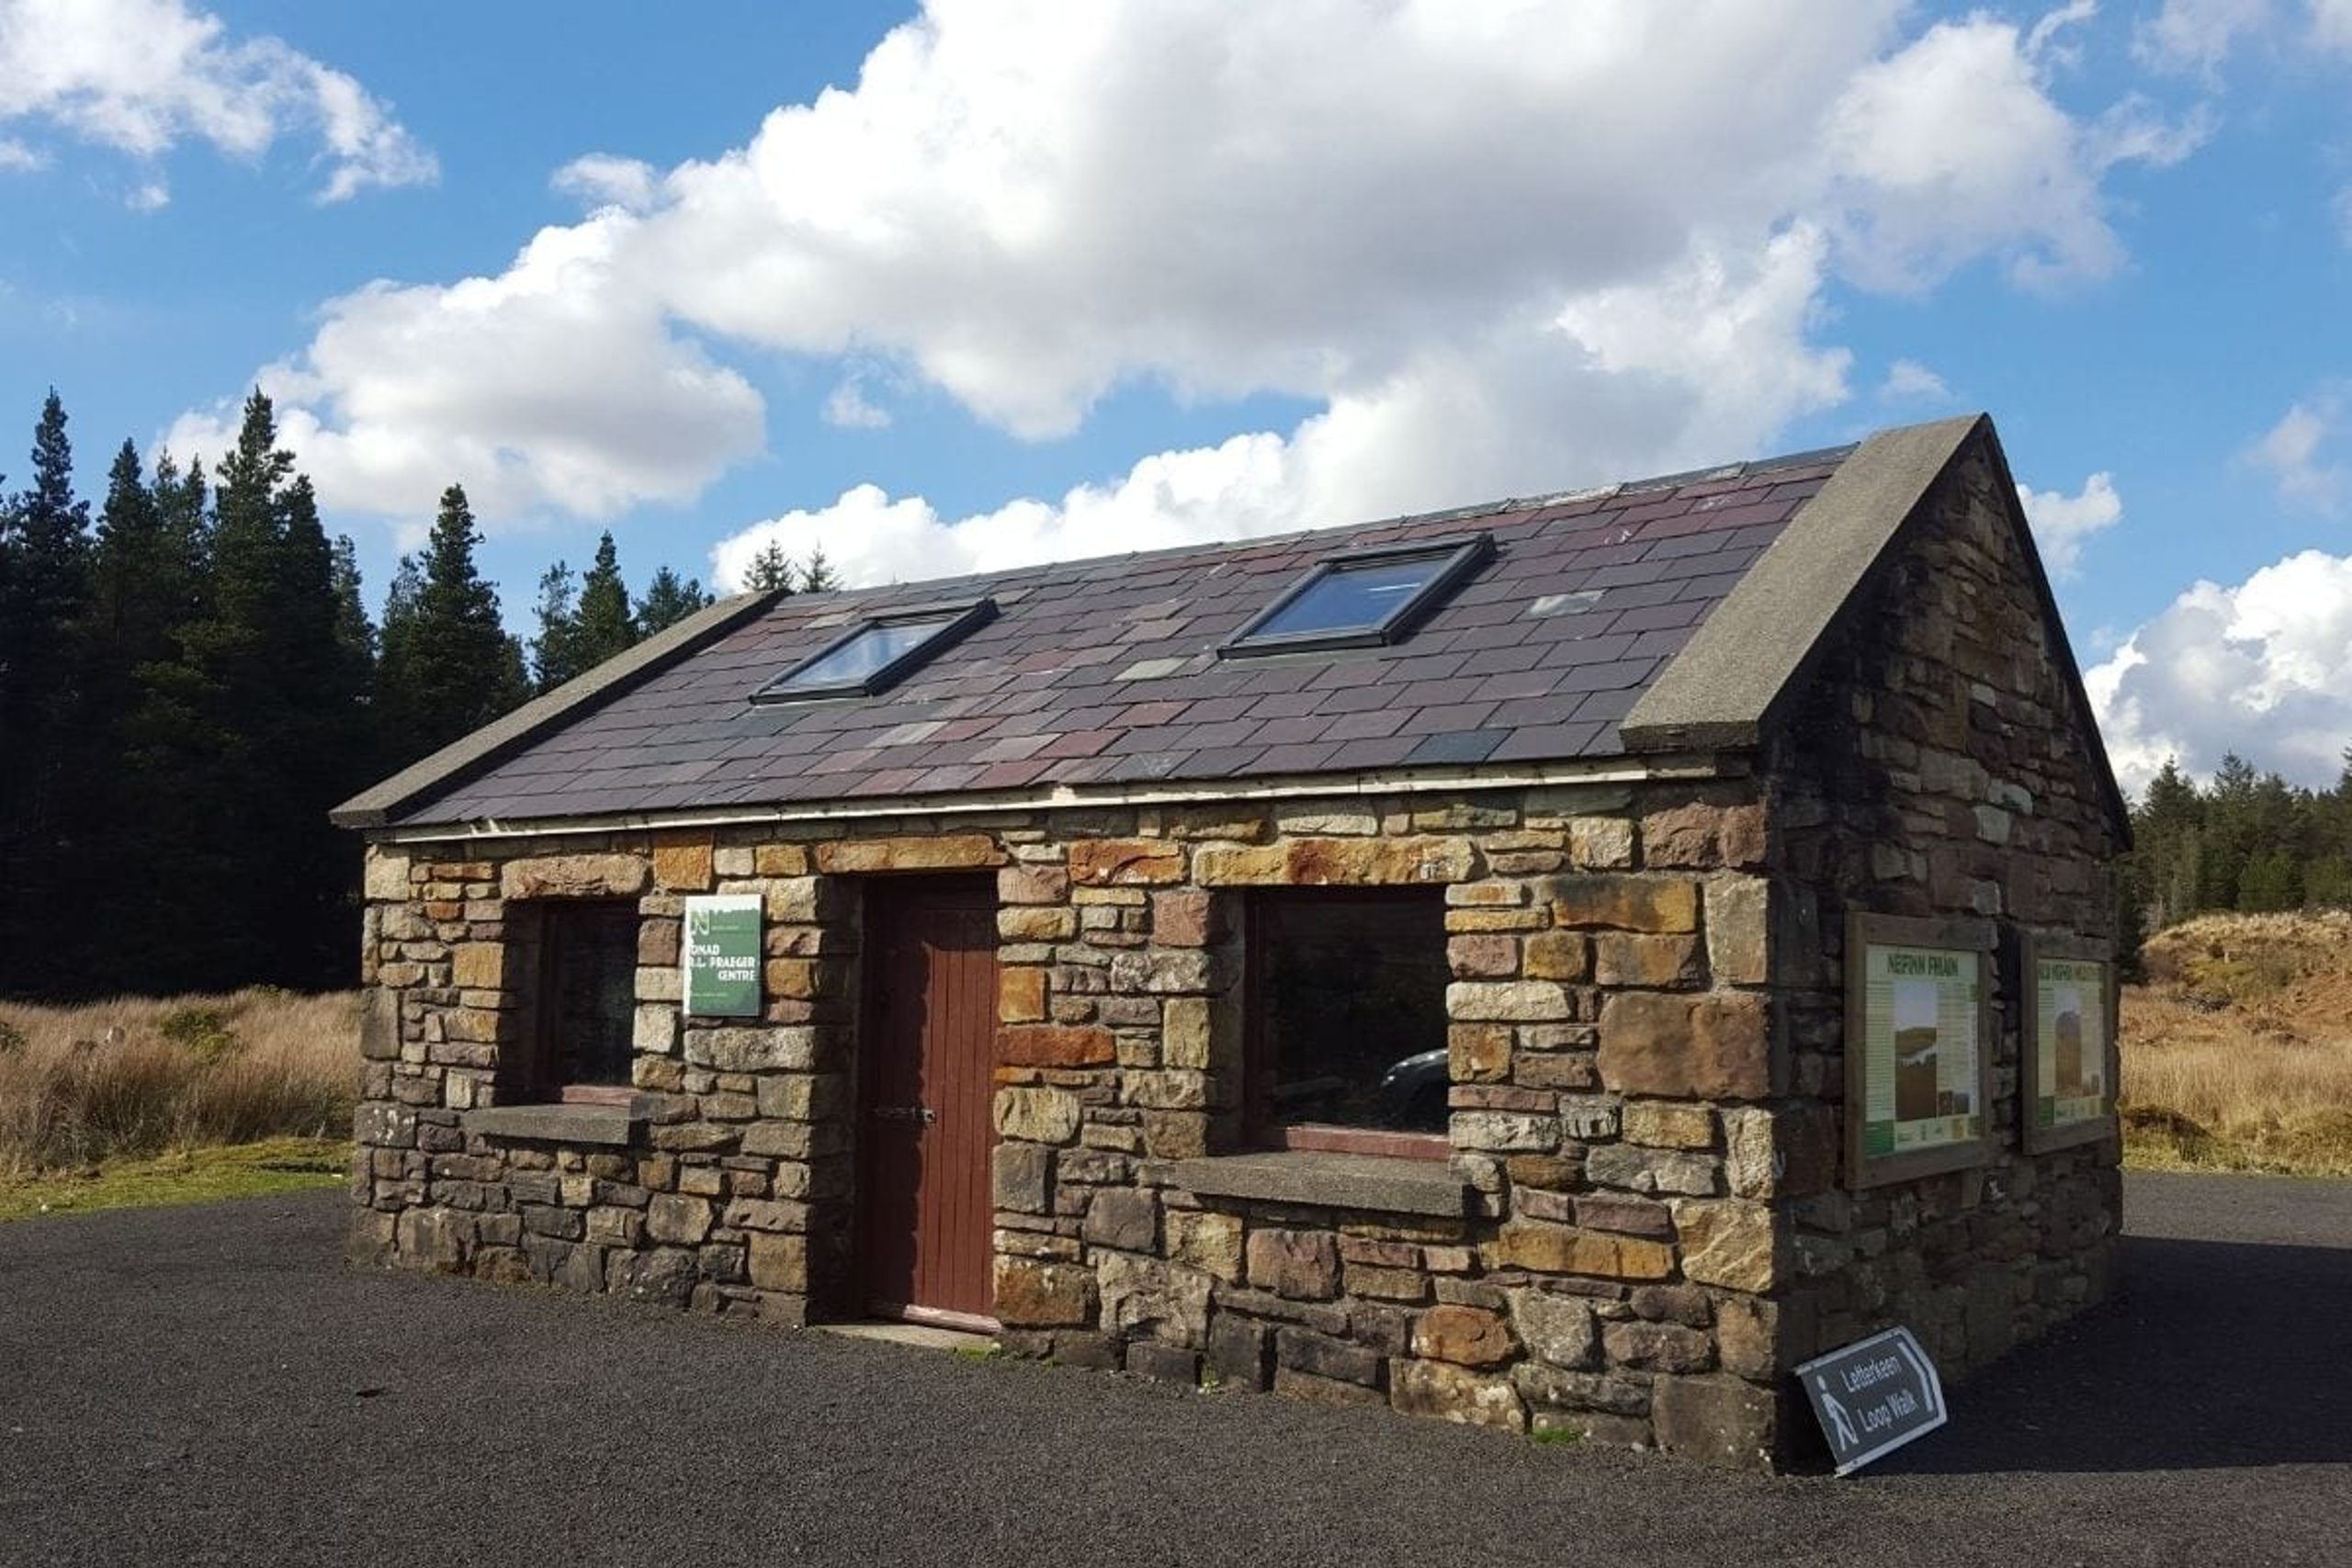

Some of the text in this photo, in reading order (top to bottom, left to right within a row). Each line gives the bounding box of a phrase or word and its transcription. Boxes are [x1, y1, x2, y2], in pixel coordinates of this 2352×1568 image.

[718, 970, 756, 981] CENTRE
[1839, 1356, 1902, 1393] Letterkeen
[1884, 1389, 1919, 1418] Walk
